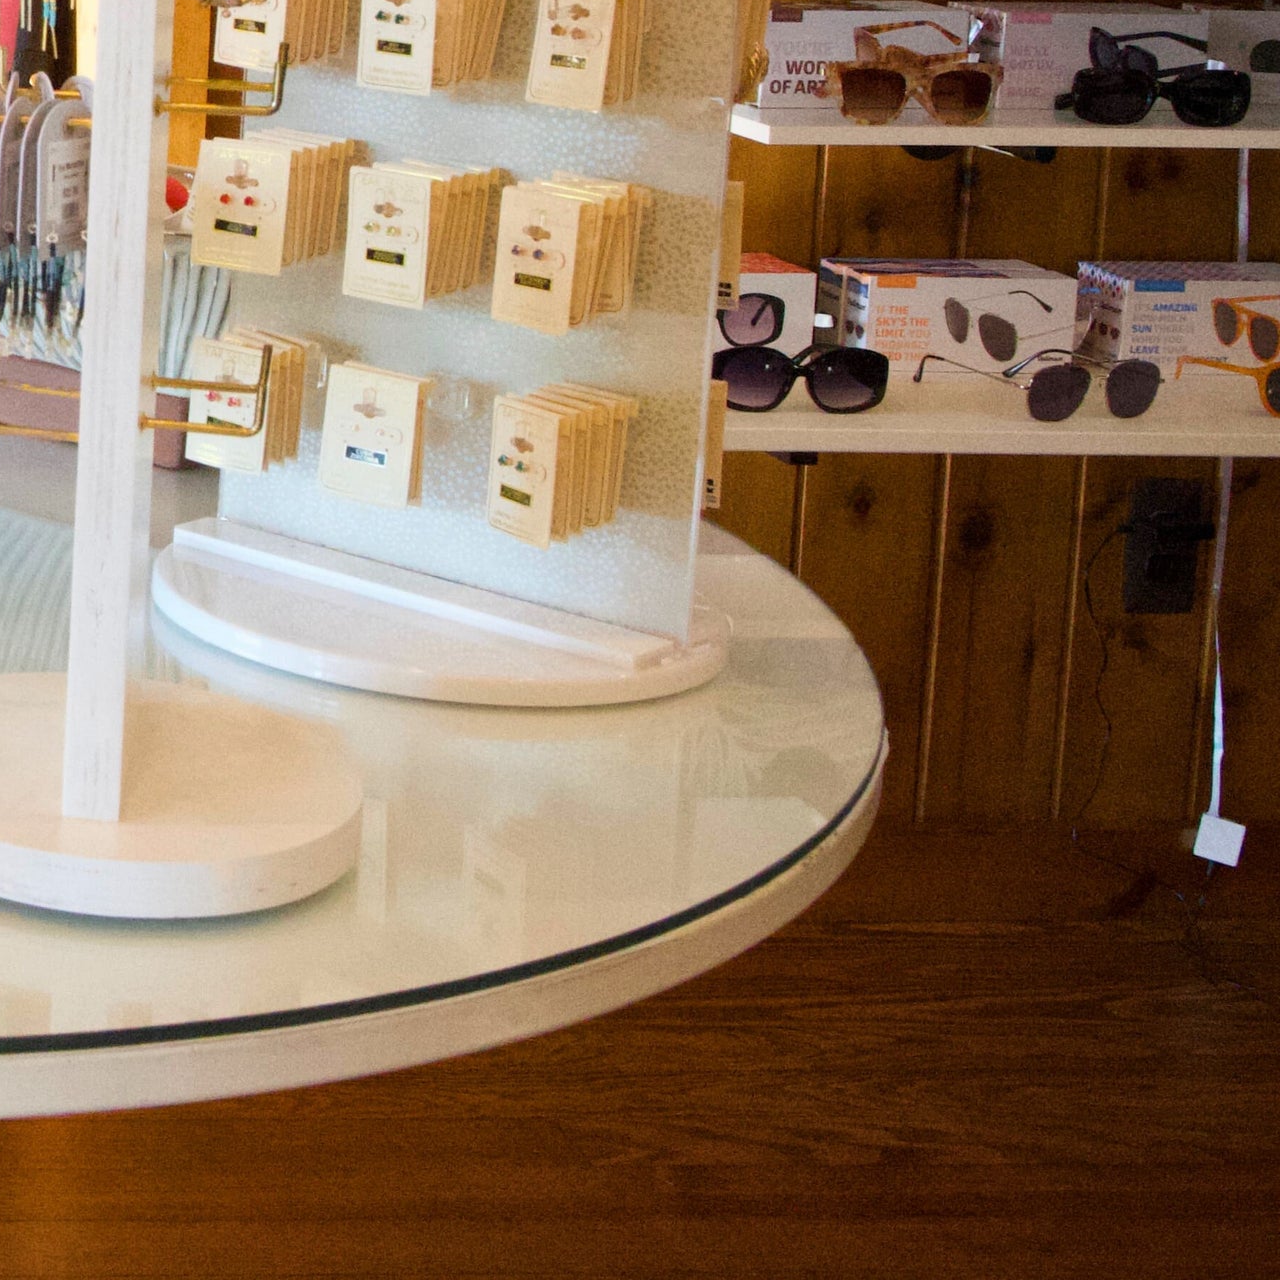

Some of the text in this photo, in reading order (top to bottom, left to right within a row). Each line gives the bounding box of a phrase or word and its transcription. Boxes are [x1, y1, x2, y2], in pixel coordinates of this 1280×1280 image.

[786, 60, 832, 75] WOR
[770, 80, 792, 94] OF
[1152, 303, 1198, 312] AMAZING
[1131, 324, 1152, 333] SUN
[1129, 346, 1160, 354] LEAVE
